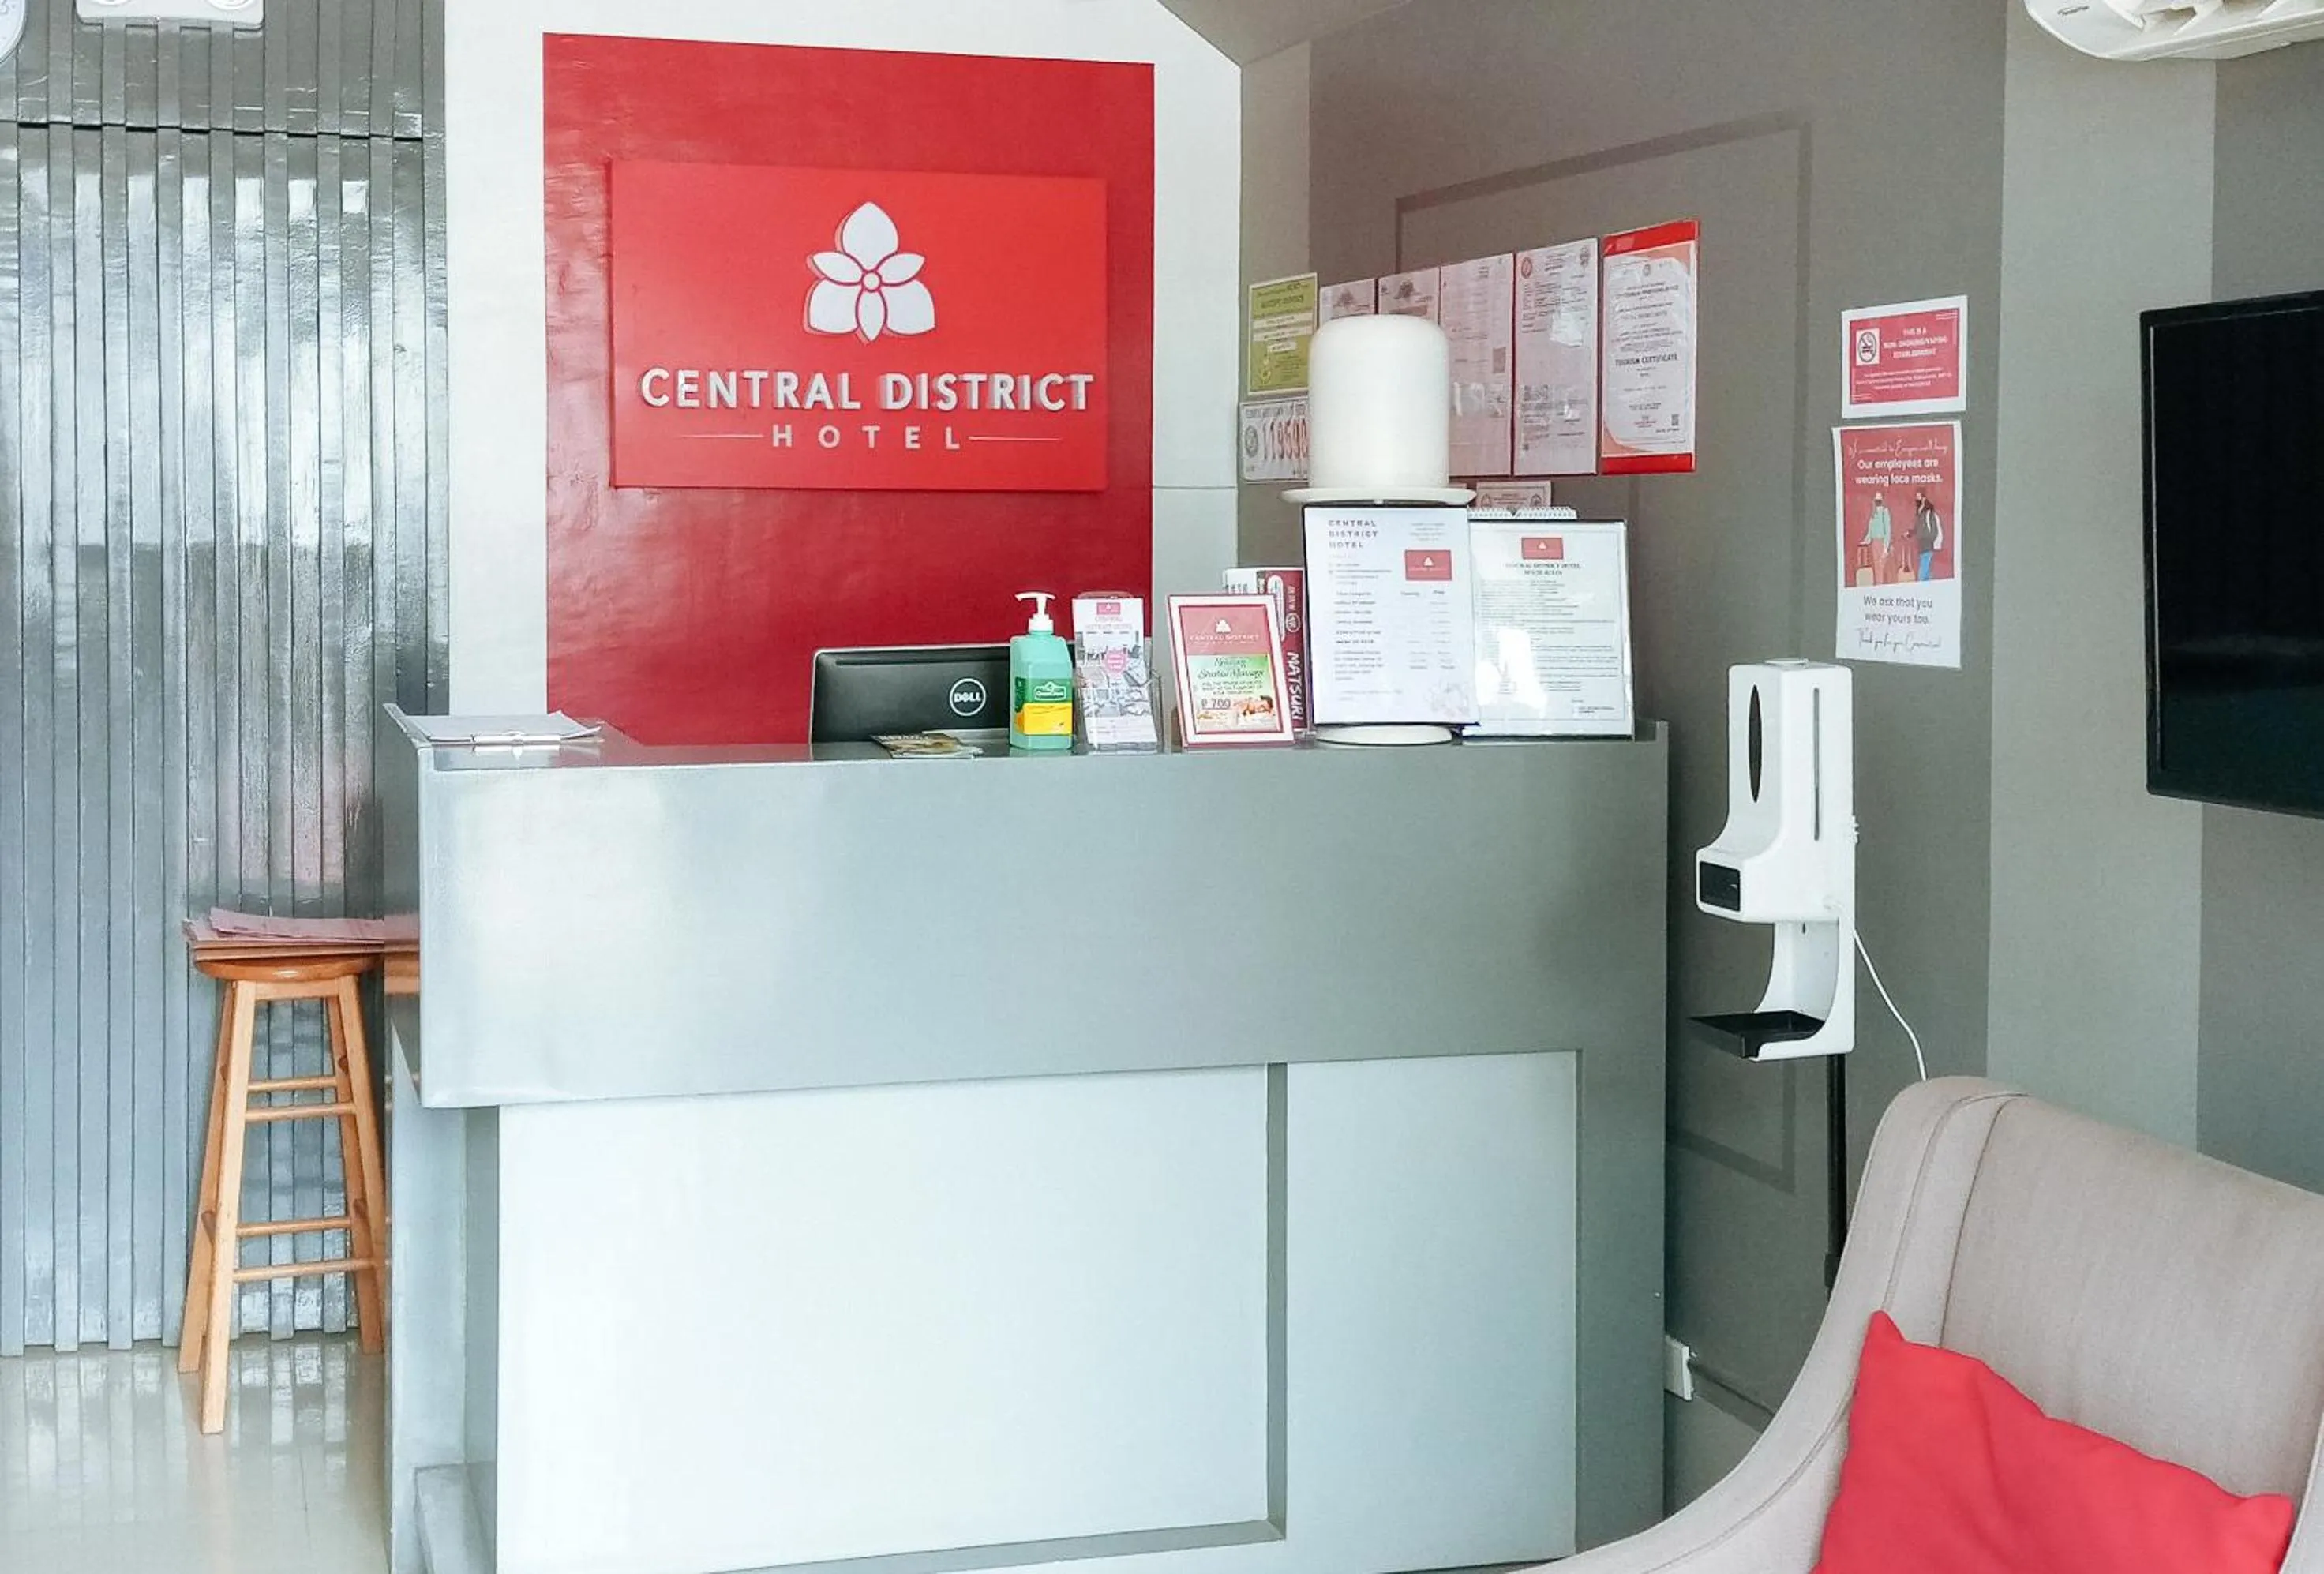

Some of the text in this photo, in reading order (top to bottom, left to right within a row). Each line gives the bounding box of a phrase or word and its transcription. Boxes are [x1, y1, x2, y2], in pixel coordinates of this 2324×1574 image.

[639, 367, 1094, 412] CENTRAL DISTRICT
[771, 423, 961, 450] HOTEL
[1857, 458, 1939, 471] Our employees are
[1855, 474, 1889, 487] wearing
[1891, 473, 1910, 484] face
[1863, 595, 1933, 610] We ask that you
[1865, 613, 1885, 622] wear
[1887, 614, 1911, 625] yours
[1287, 652, 1303, 720] MATSURI
[954, 691, 982, 703] DELL
[1212, 698, 1231, 709] 700
